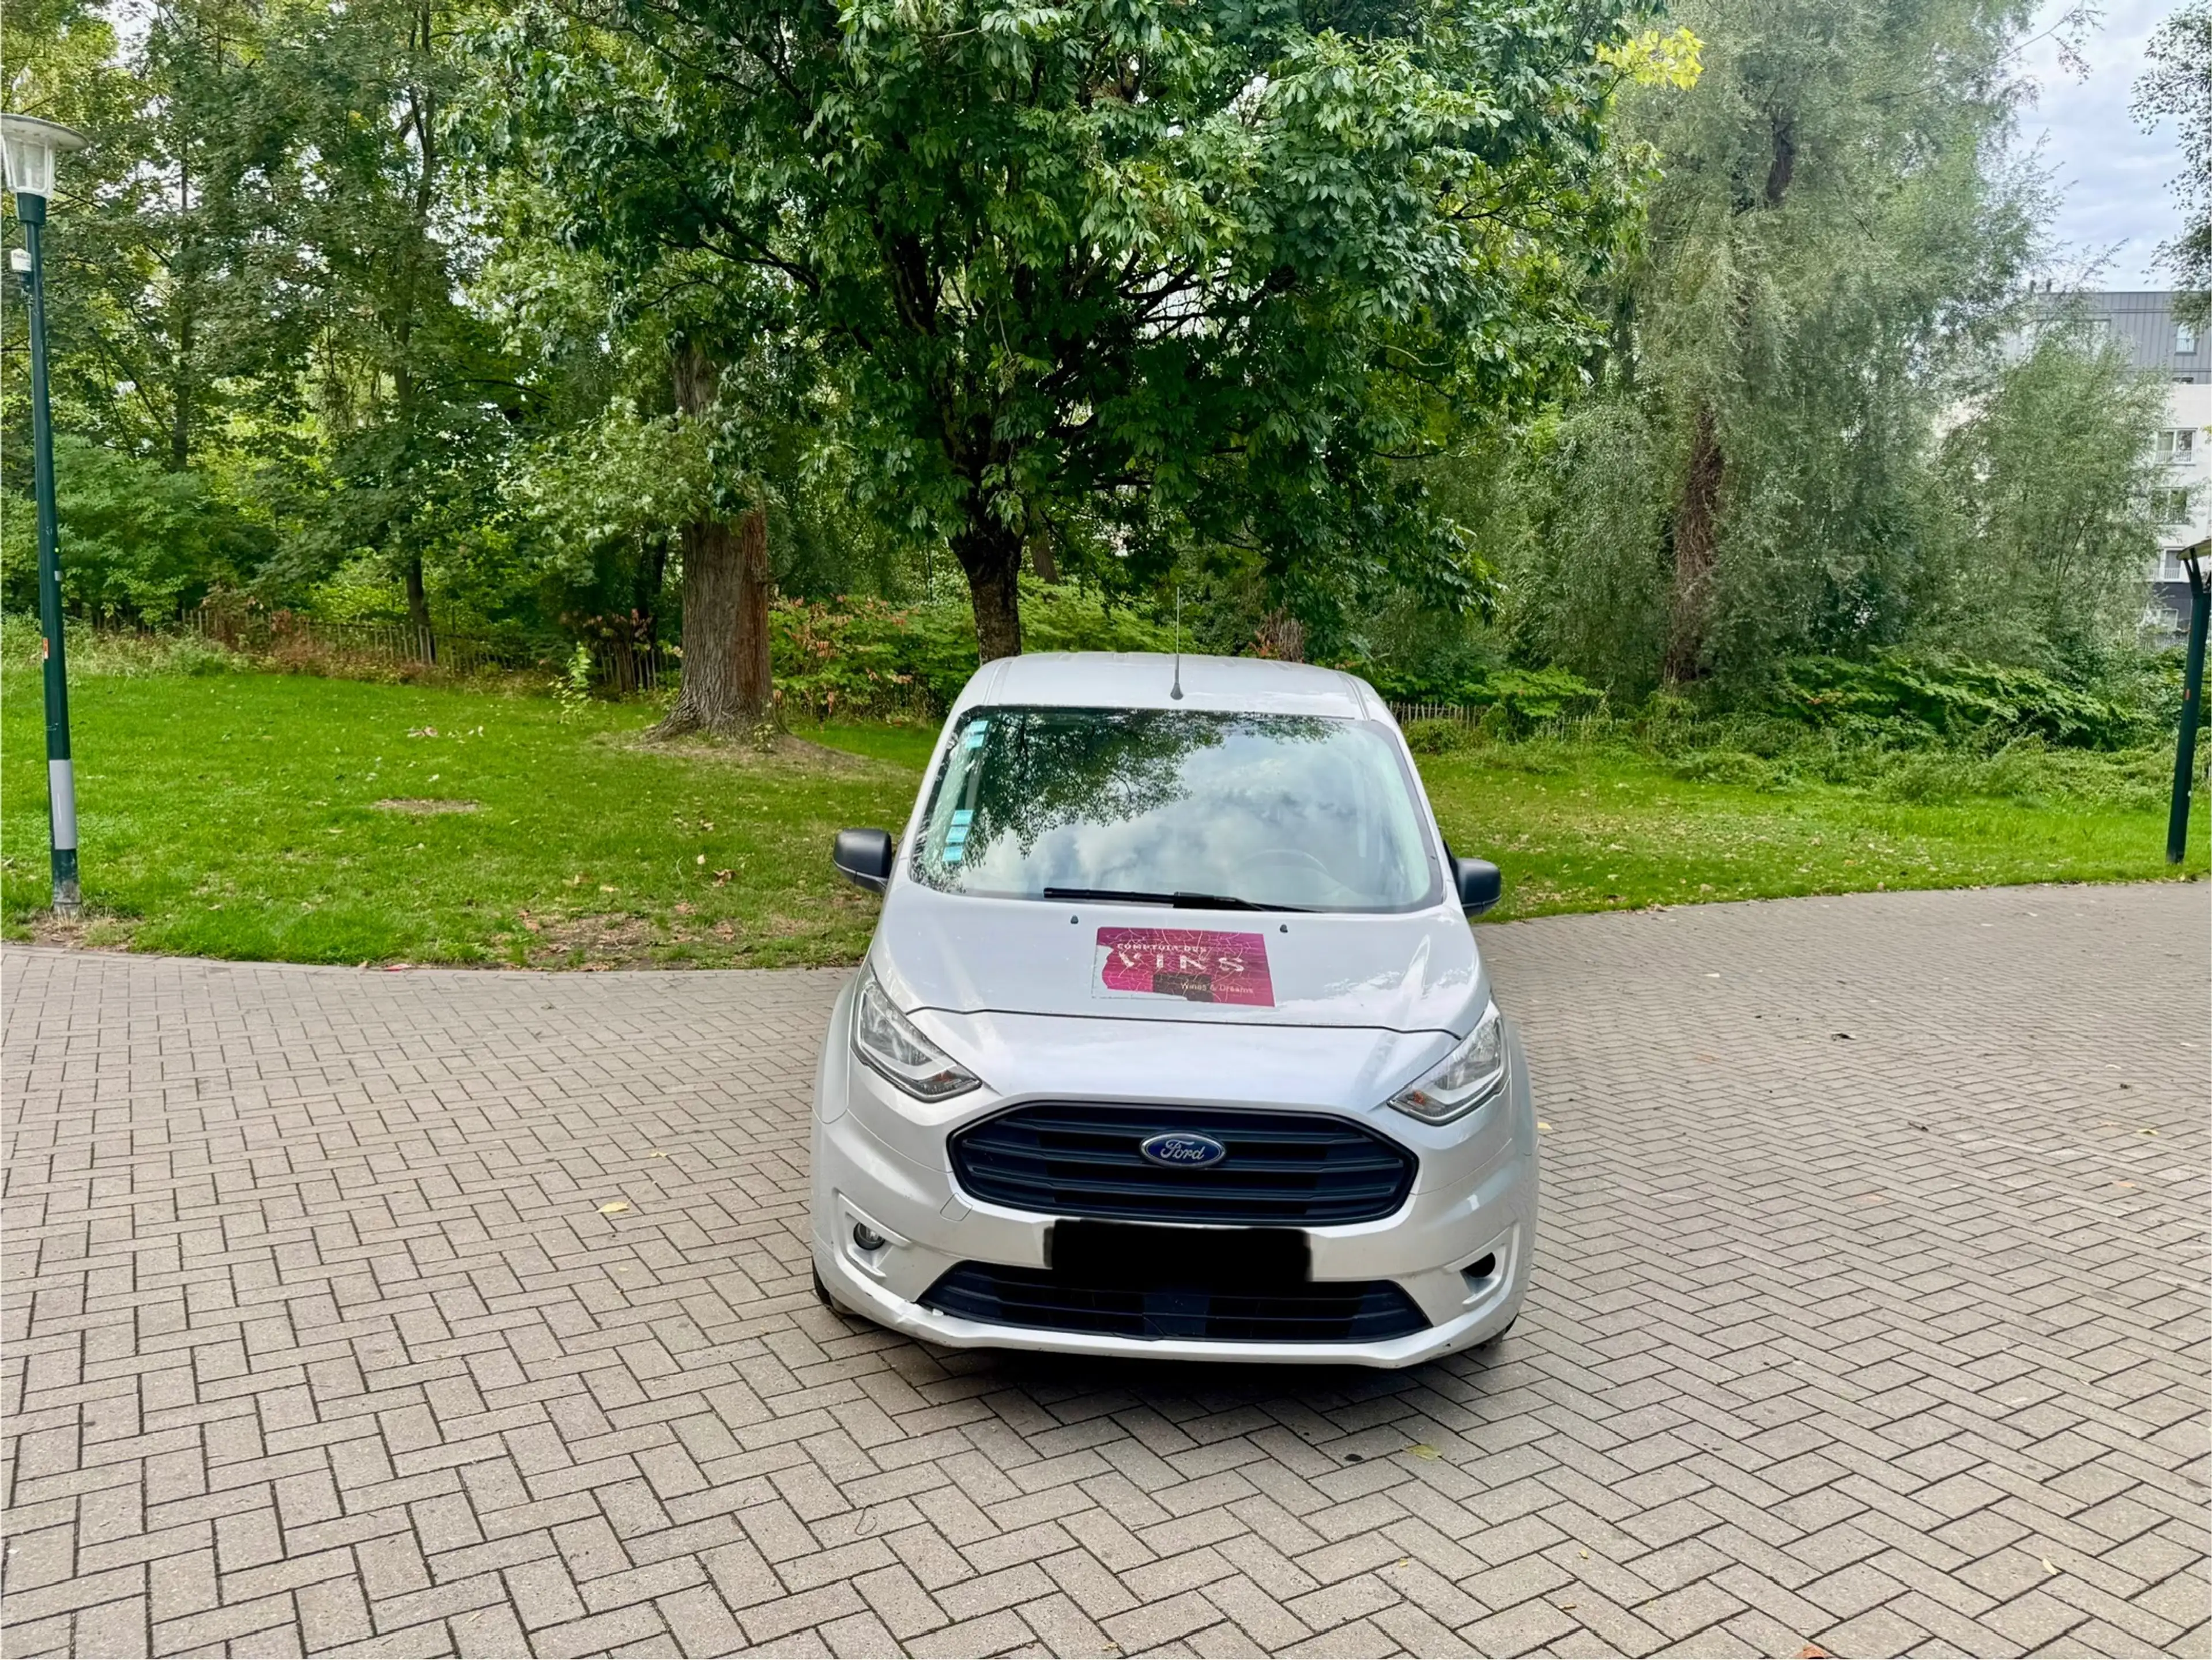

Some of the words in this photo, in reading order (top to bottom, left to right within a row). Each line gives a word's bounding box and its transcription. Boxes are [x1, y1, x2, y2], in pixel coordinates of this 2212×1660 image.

[1118, 952, 1245, 972] VINS
[1219, 983, 1254, 994] Dreams
[1160, 1139, 1206, 1160] Ford
